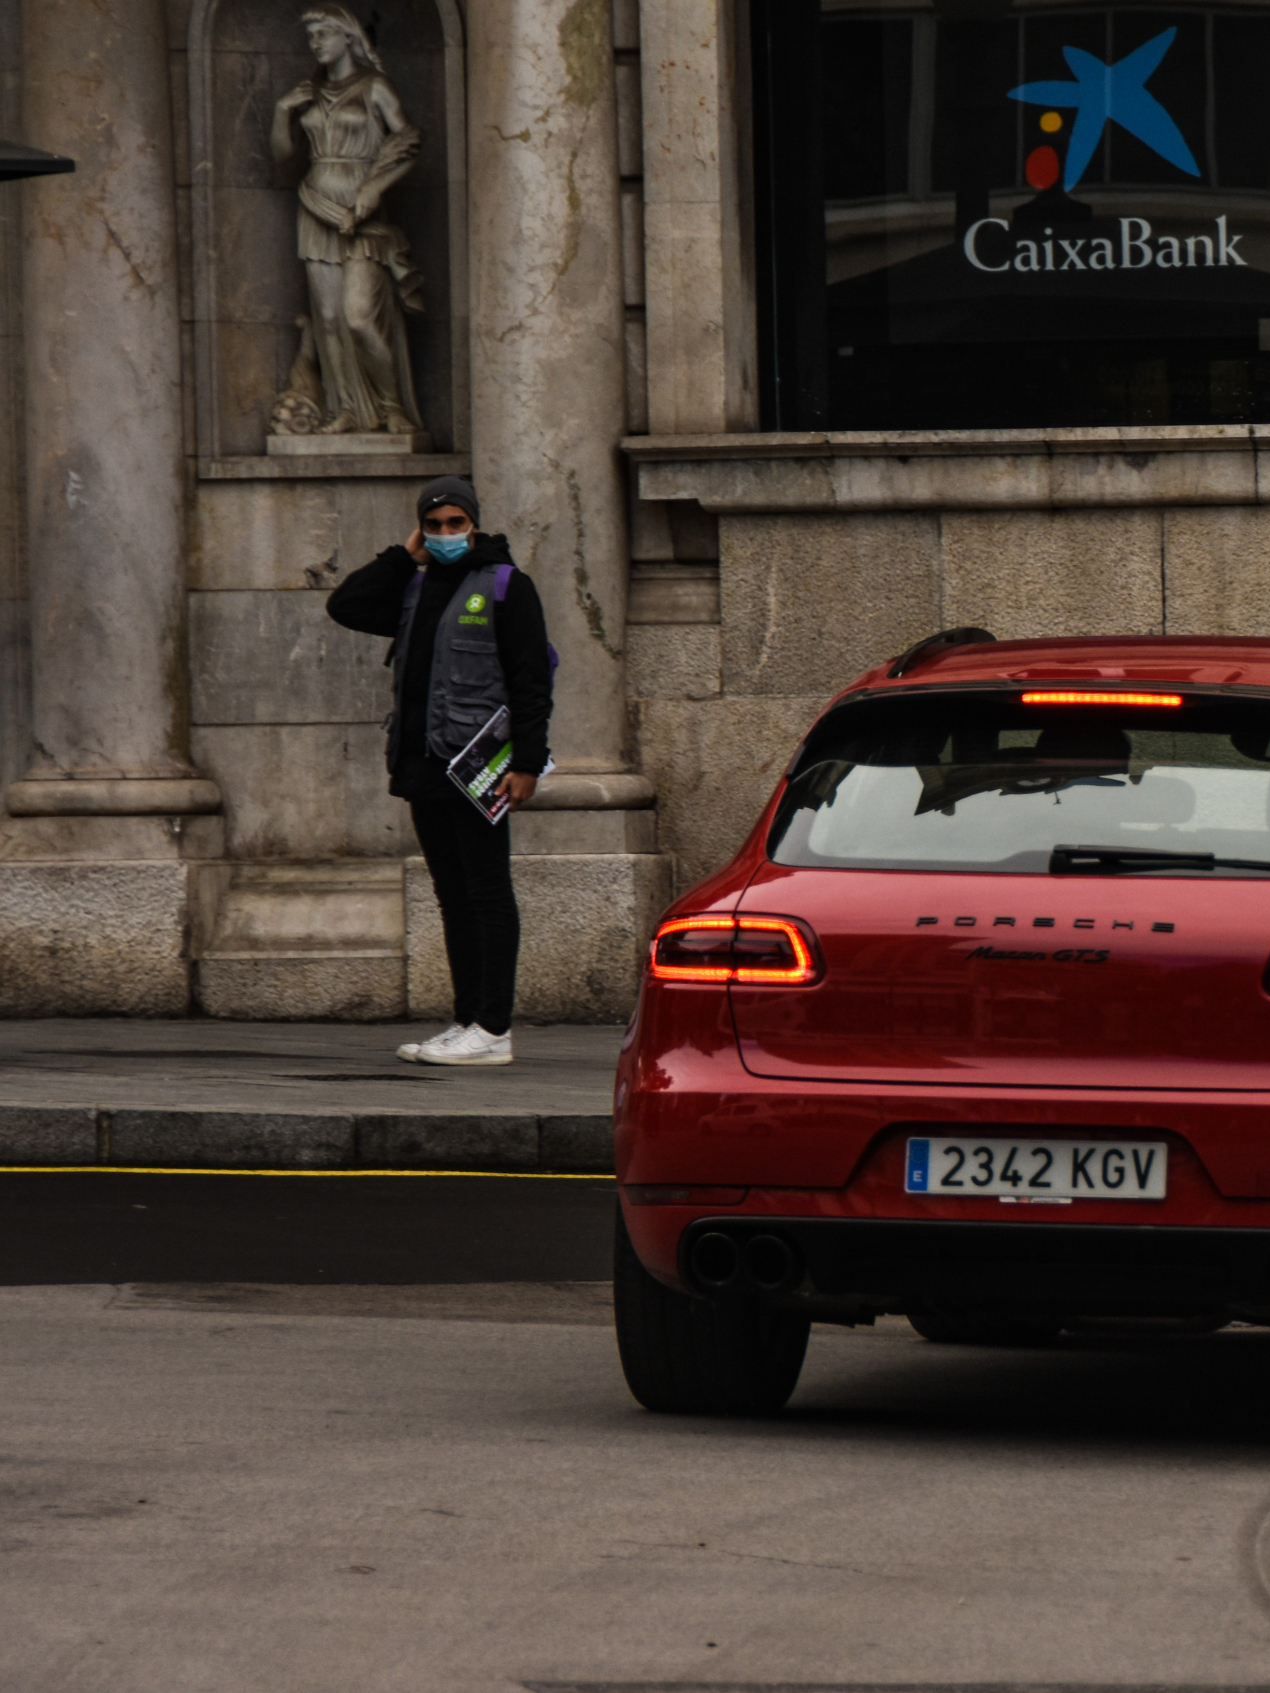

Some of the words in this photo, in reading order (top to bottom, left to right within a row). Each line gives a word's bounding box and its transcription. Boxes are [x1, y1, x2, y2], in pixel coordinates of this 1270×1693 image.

[964, 214, 1248, 272] CaixaBank
[916, 916, 1175, 933] PORSCHE
[966, 946, 1046, 960] Macan
[1053, 949, 1110, 963] GTS
[913, 1170, 922, 1182] E
[940, 1145, 1053, 1188] 2342
[1071, 1147, 1156, 1190] KGV
